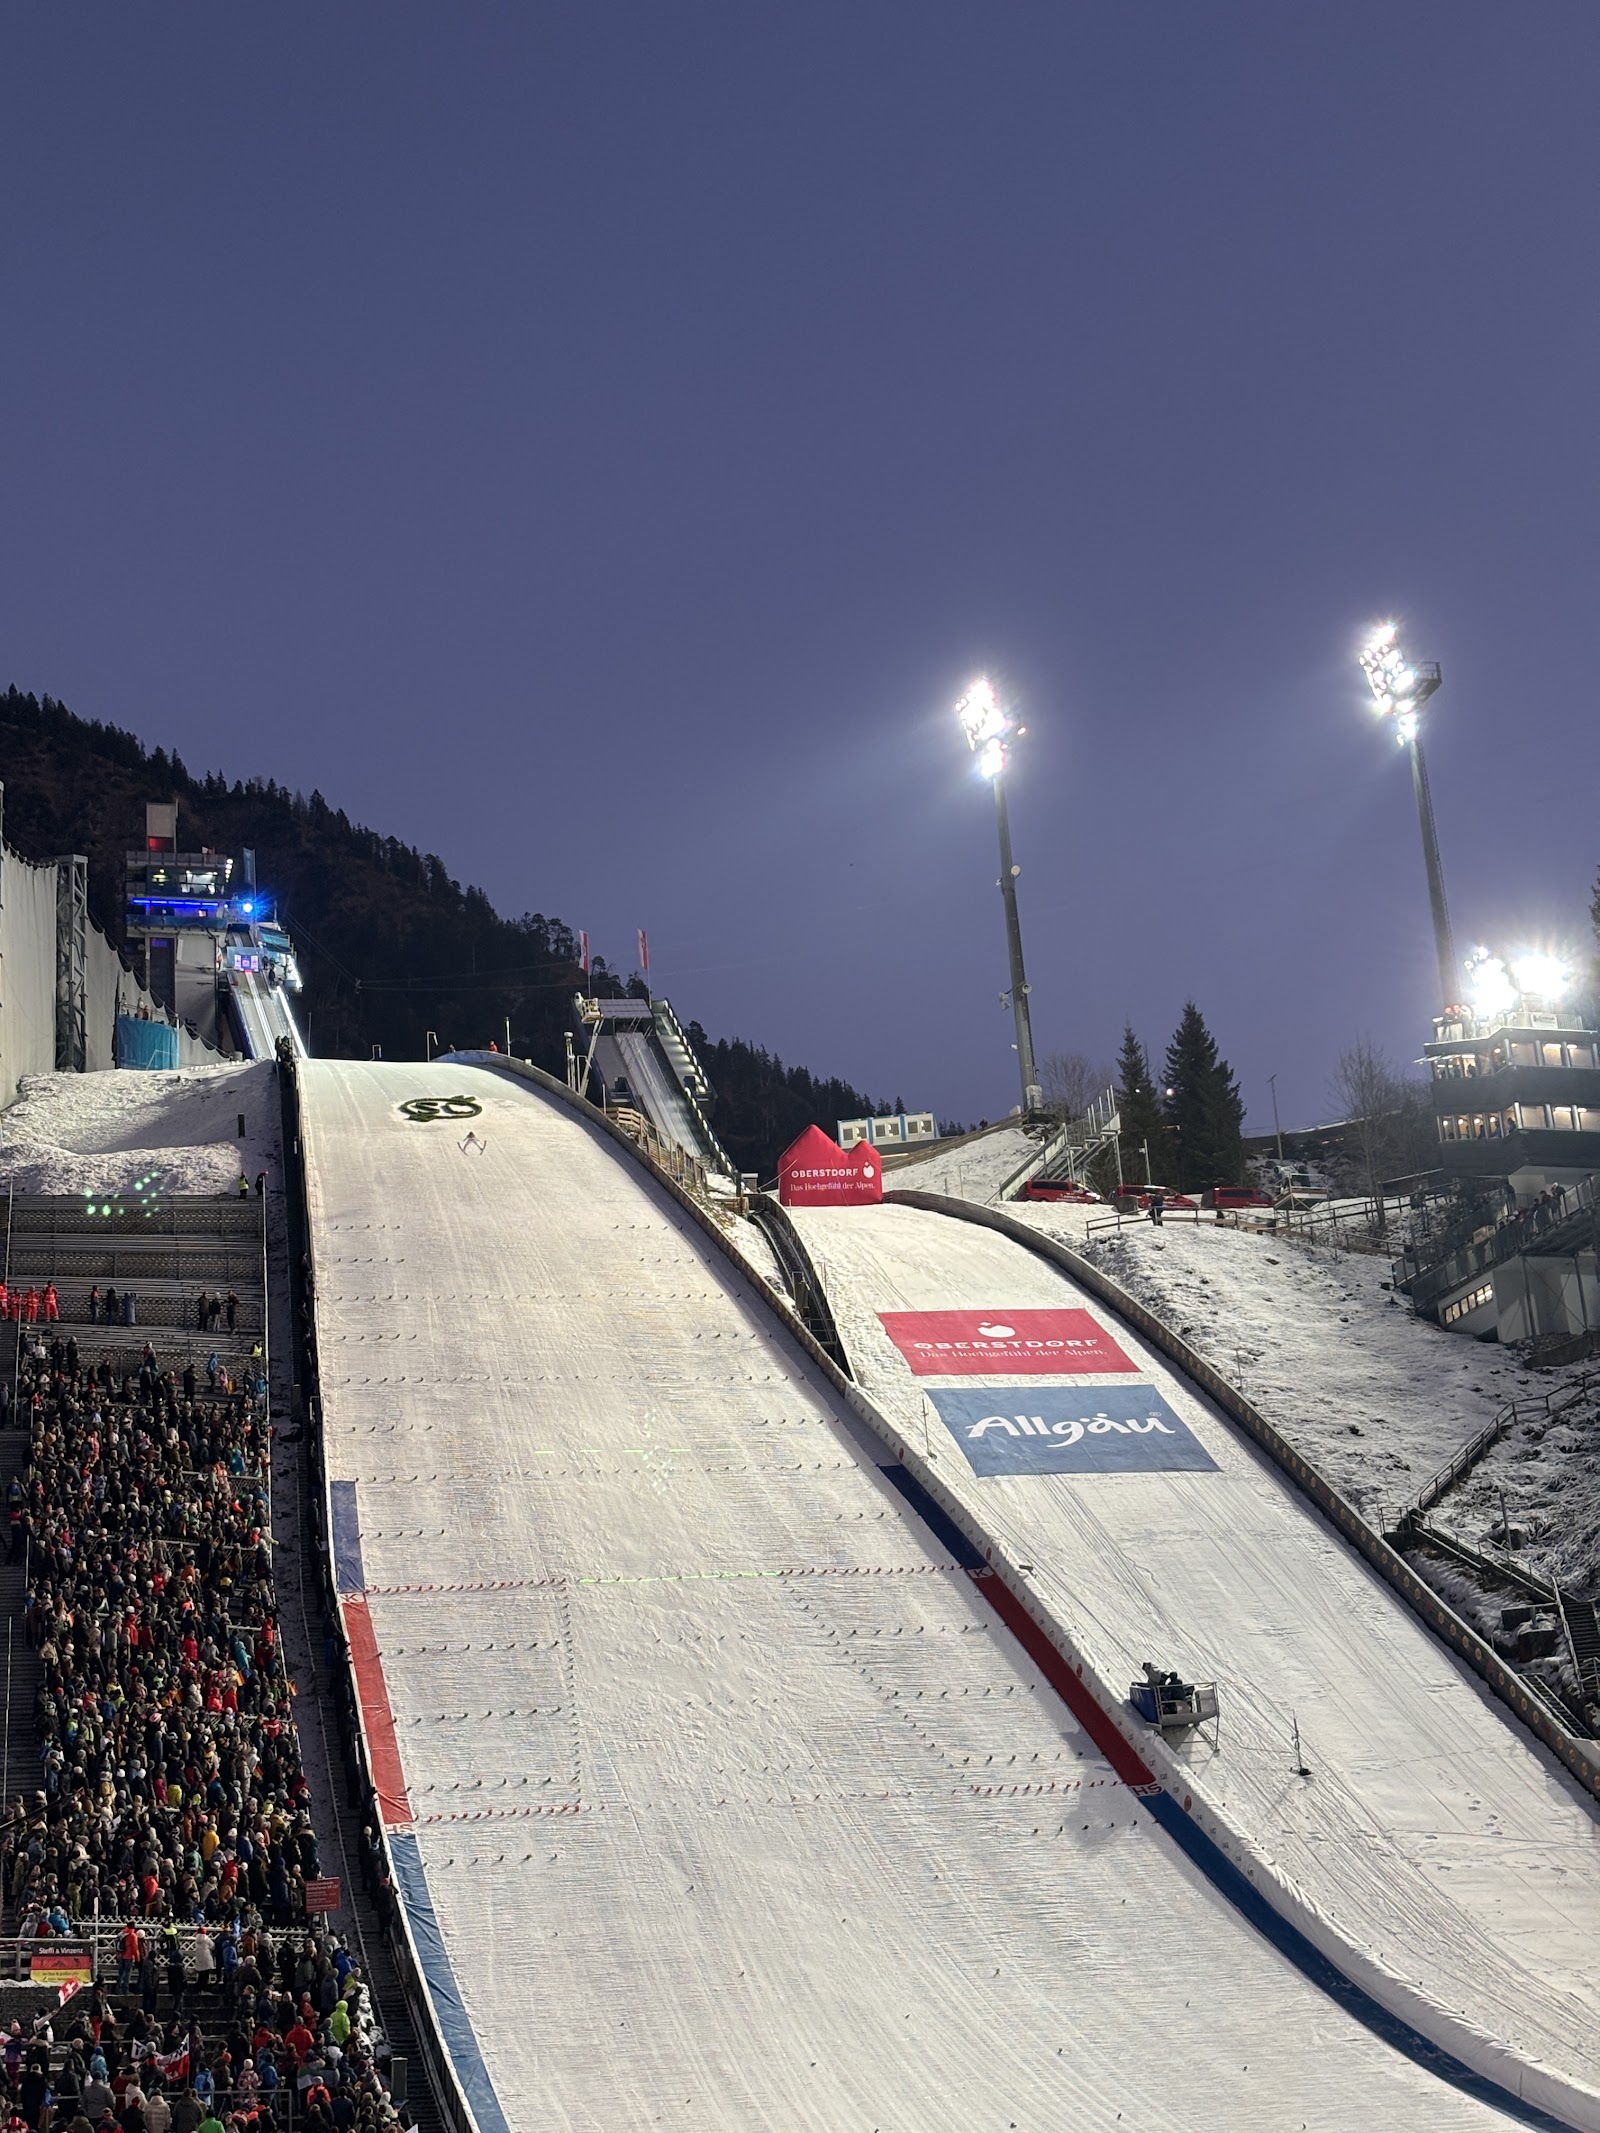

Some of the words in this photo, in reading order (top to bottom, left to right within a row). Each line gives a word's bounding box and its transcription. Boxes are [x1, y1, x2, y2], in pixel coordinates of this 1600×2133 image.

[791, 1168, 858, 1178] OBERSTDORF
[790, 1183, 803, 1191] Das
[805, 1182, 841, 1191] Hochgefühl
[842, 1182, 854, 1190] der
[855, 1181, 875, 1191] Alpen.
[913, 1339, 1098, 1350] OBERSTDORF
[920, 1350, 948, 1358] Das
[951, 1349, 1031, 1358] Hochgefühl
[1064, 1349, 1108, 1357] Alpen.
[965, 1413, 1176, 1448] Allgäu
[1132, 1783, 1163, 1796] HS
[384, 1823, 414, 1834] HS
